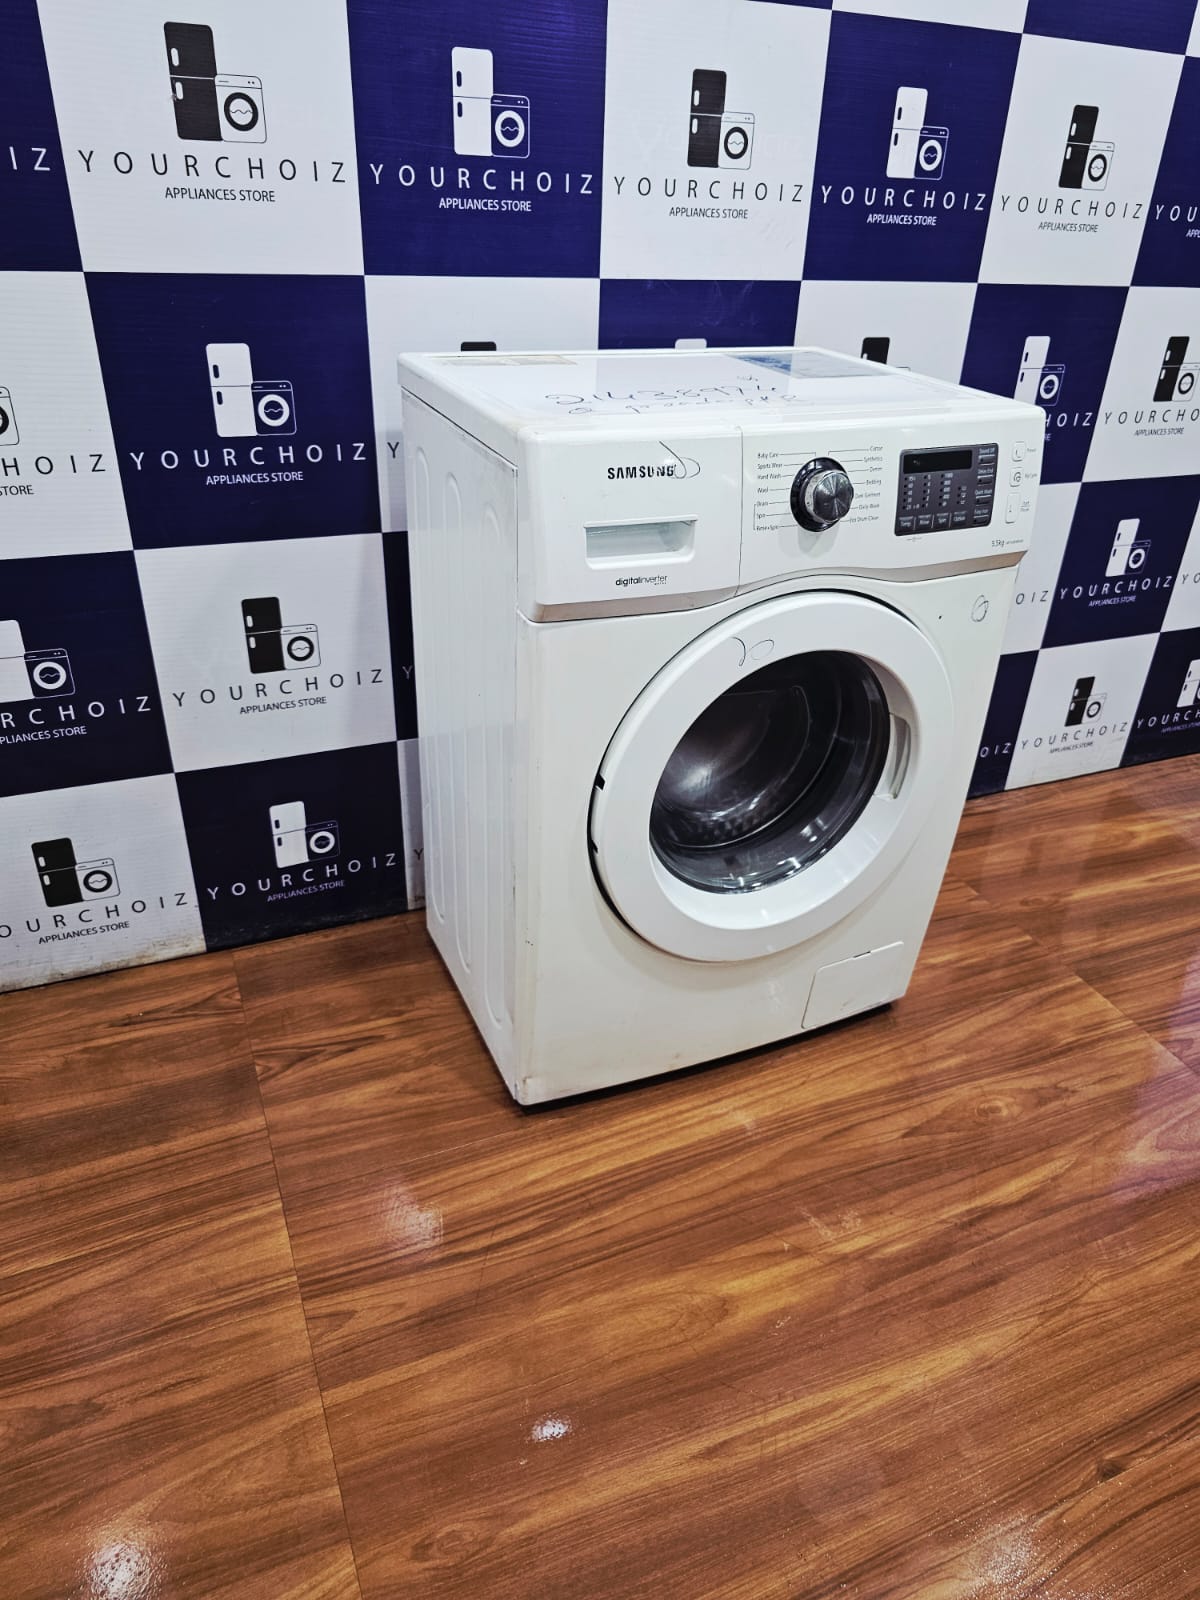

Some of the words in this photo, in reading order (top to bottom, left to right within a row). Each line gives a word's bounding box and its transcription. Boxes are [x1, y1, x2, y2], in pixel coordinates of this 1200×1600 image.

[78, 150, 345, 182] YOURCHOIZ
[370, 164, 592, 194] YOURCHOIZ
[614, 177, 803, 202] YOURCHOIZ
[165, 187, 236, 200] APPLIANCES
[239, 190, 275, 202] STORE
[439, 198, 499, 210] APPLIANCES
[501, 200, 531, 211] STORE
[822, 186, 985, 210] YOURCHOIZ
[670, 207, 720, 218] APPLIANCES
[723, 209, 748, 219] STORE
[1002, 195, 1142, 218] YOURCHOIZ
[867, 214, 911, 224] APPLIANCES
[912, 215, 938, 226] STORE
[1039, 222, 1075, 231] APPLIANCES
[1076, 223, 1099, 233] STORE
[130, 442, 366, 471] YOURCHOIZ
[206, 473, 269, 485] APPLIANCES
[272, 472, 303, 482] STORE
[607, 465, 675, 480] SAMSUNG
[1060, 576, 1173, 599] YOURCHOIZ
[173, 669, 383, 707] YOURCHOIZ
[239, 699, 297, 715] APPLIANCES
[298, 697, 326, 707] STORE
[53, 726, 87, 738] STORE
[1021, 722, 1128, 749] YOURCHOIZ
[208, 853, 396, 901] YOURCHOIZ
[266, 887, 319, 902] APPLIANCES
[320, 880, 343, 890] STORE
[38, 926, 98, 944] APPLIANCES
[99, 921, 129, 933] STORE
